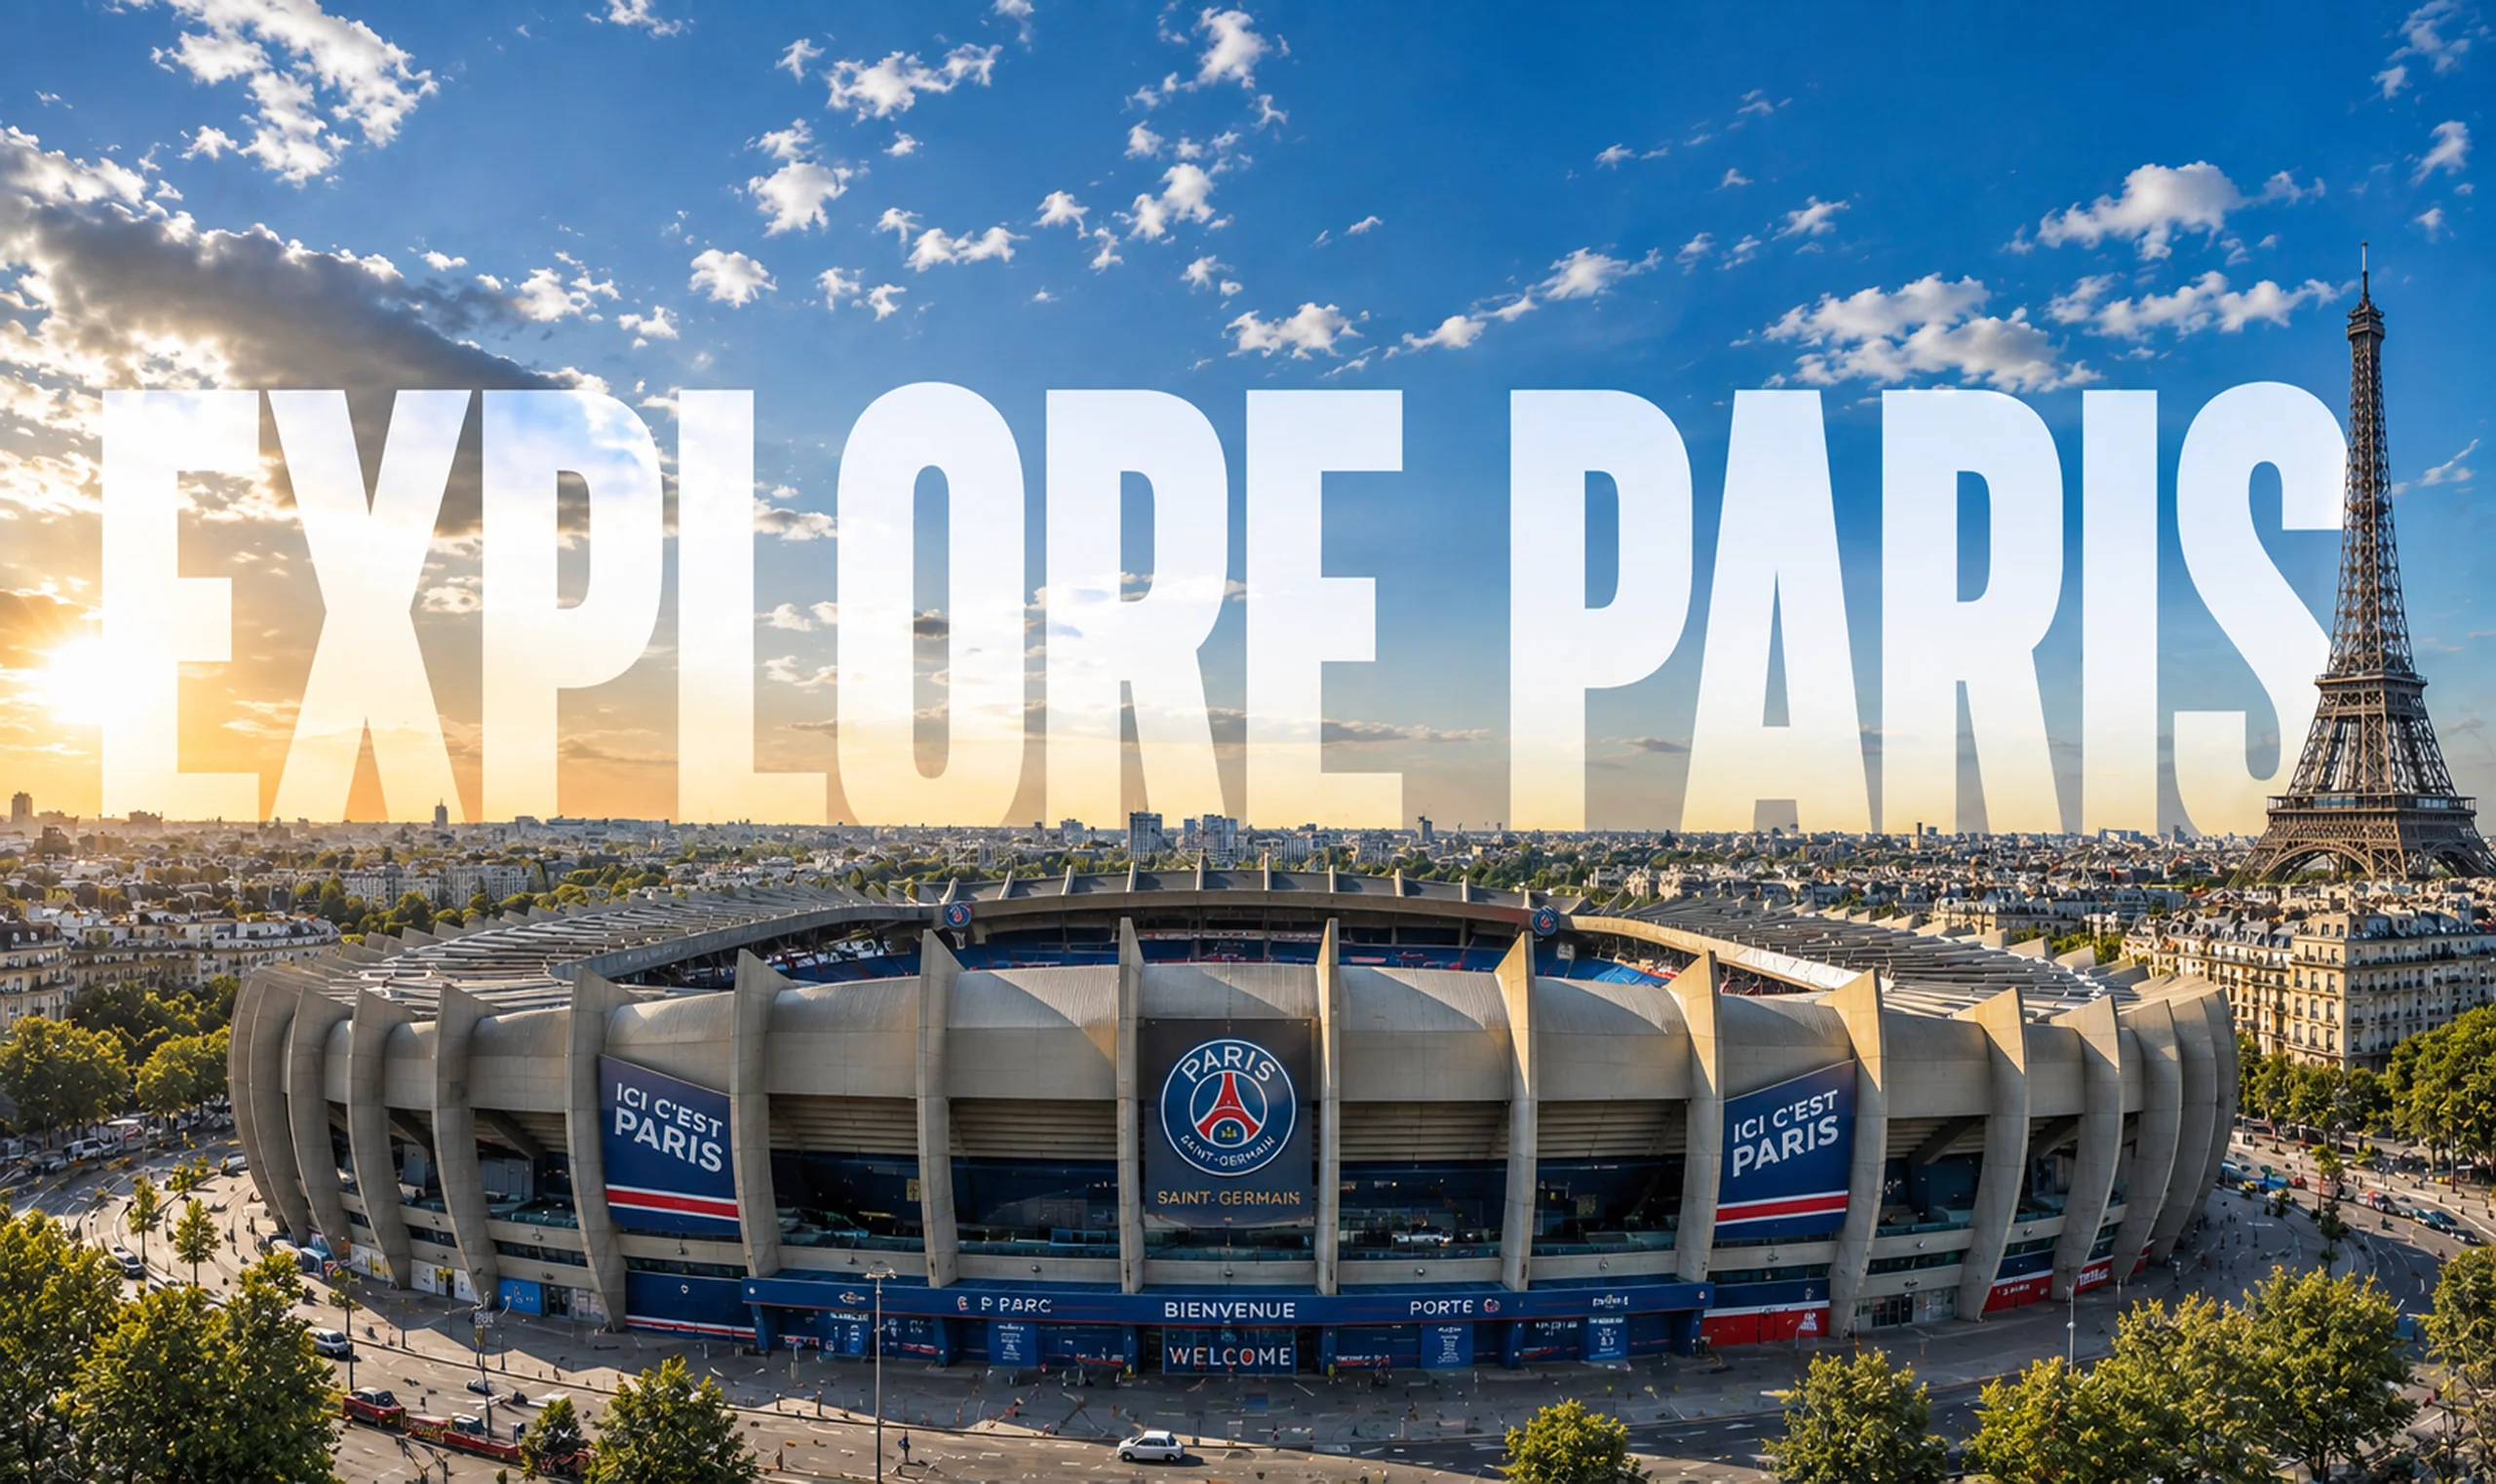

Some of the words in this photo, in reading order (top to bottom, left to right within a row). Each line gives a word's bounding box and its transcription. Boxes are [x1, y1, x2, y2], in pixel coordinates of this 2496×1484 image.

[1181, 1045, 1276, 1083] PARIS
[616, 1082, 647, 1111] ICI
[654, 1099, 723, 1138] C'EST
[1734, 1114, 1765, 1143] ICI
[1773, 1089, 1839, 1128] C'EST
[614, 1106, 722, 1172] PARIS
[1733, 1114, 1839, 1178] PARIS
[999, 1298, 1052, 1313] PARC
[1164, 1302, 1295, 1318] BIENVENUE
[1410, 1300, 1474, 1315] PORTE
[1169, 1347, 1292, 1366] WELCOME
